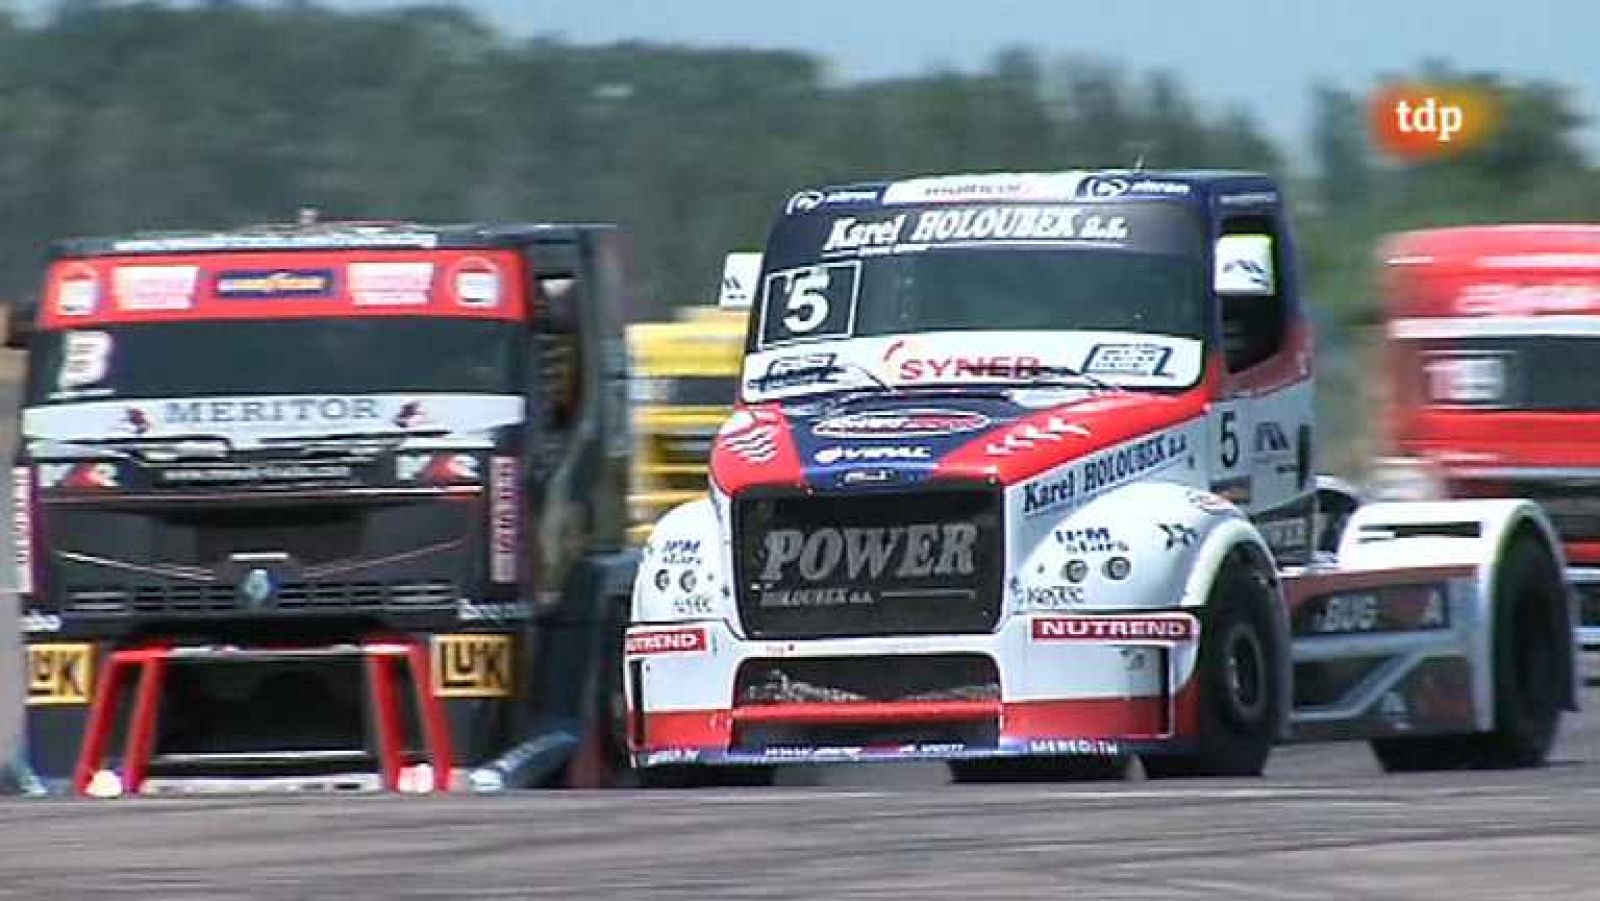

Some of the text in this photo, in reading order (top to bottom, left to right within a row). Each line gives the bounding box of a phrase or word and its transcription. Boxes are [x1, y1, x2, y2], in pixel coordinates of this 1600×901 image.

[823, 213, 907, 250] Karel
[910, 207, 1076, 240] HOLOUBEK
[783, 268, 831, 333] 5
[163, 399, 378, 424] MERITOR
[1220, 411, 1240, 468] 5
[1024, 469, 1076, 512] Karel
[1083, 434, 1166, 492] HOLOUBEK
[760, 523, 978, 581] POWER
[1040, 620, 1187, 636] NUTREND
